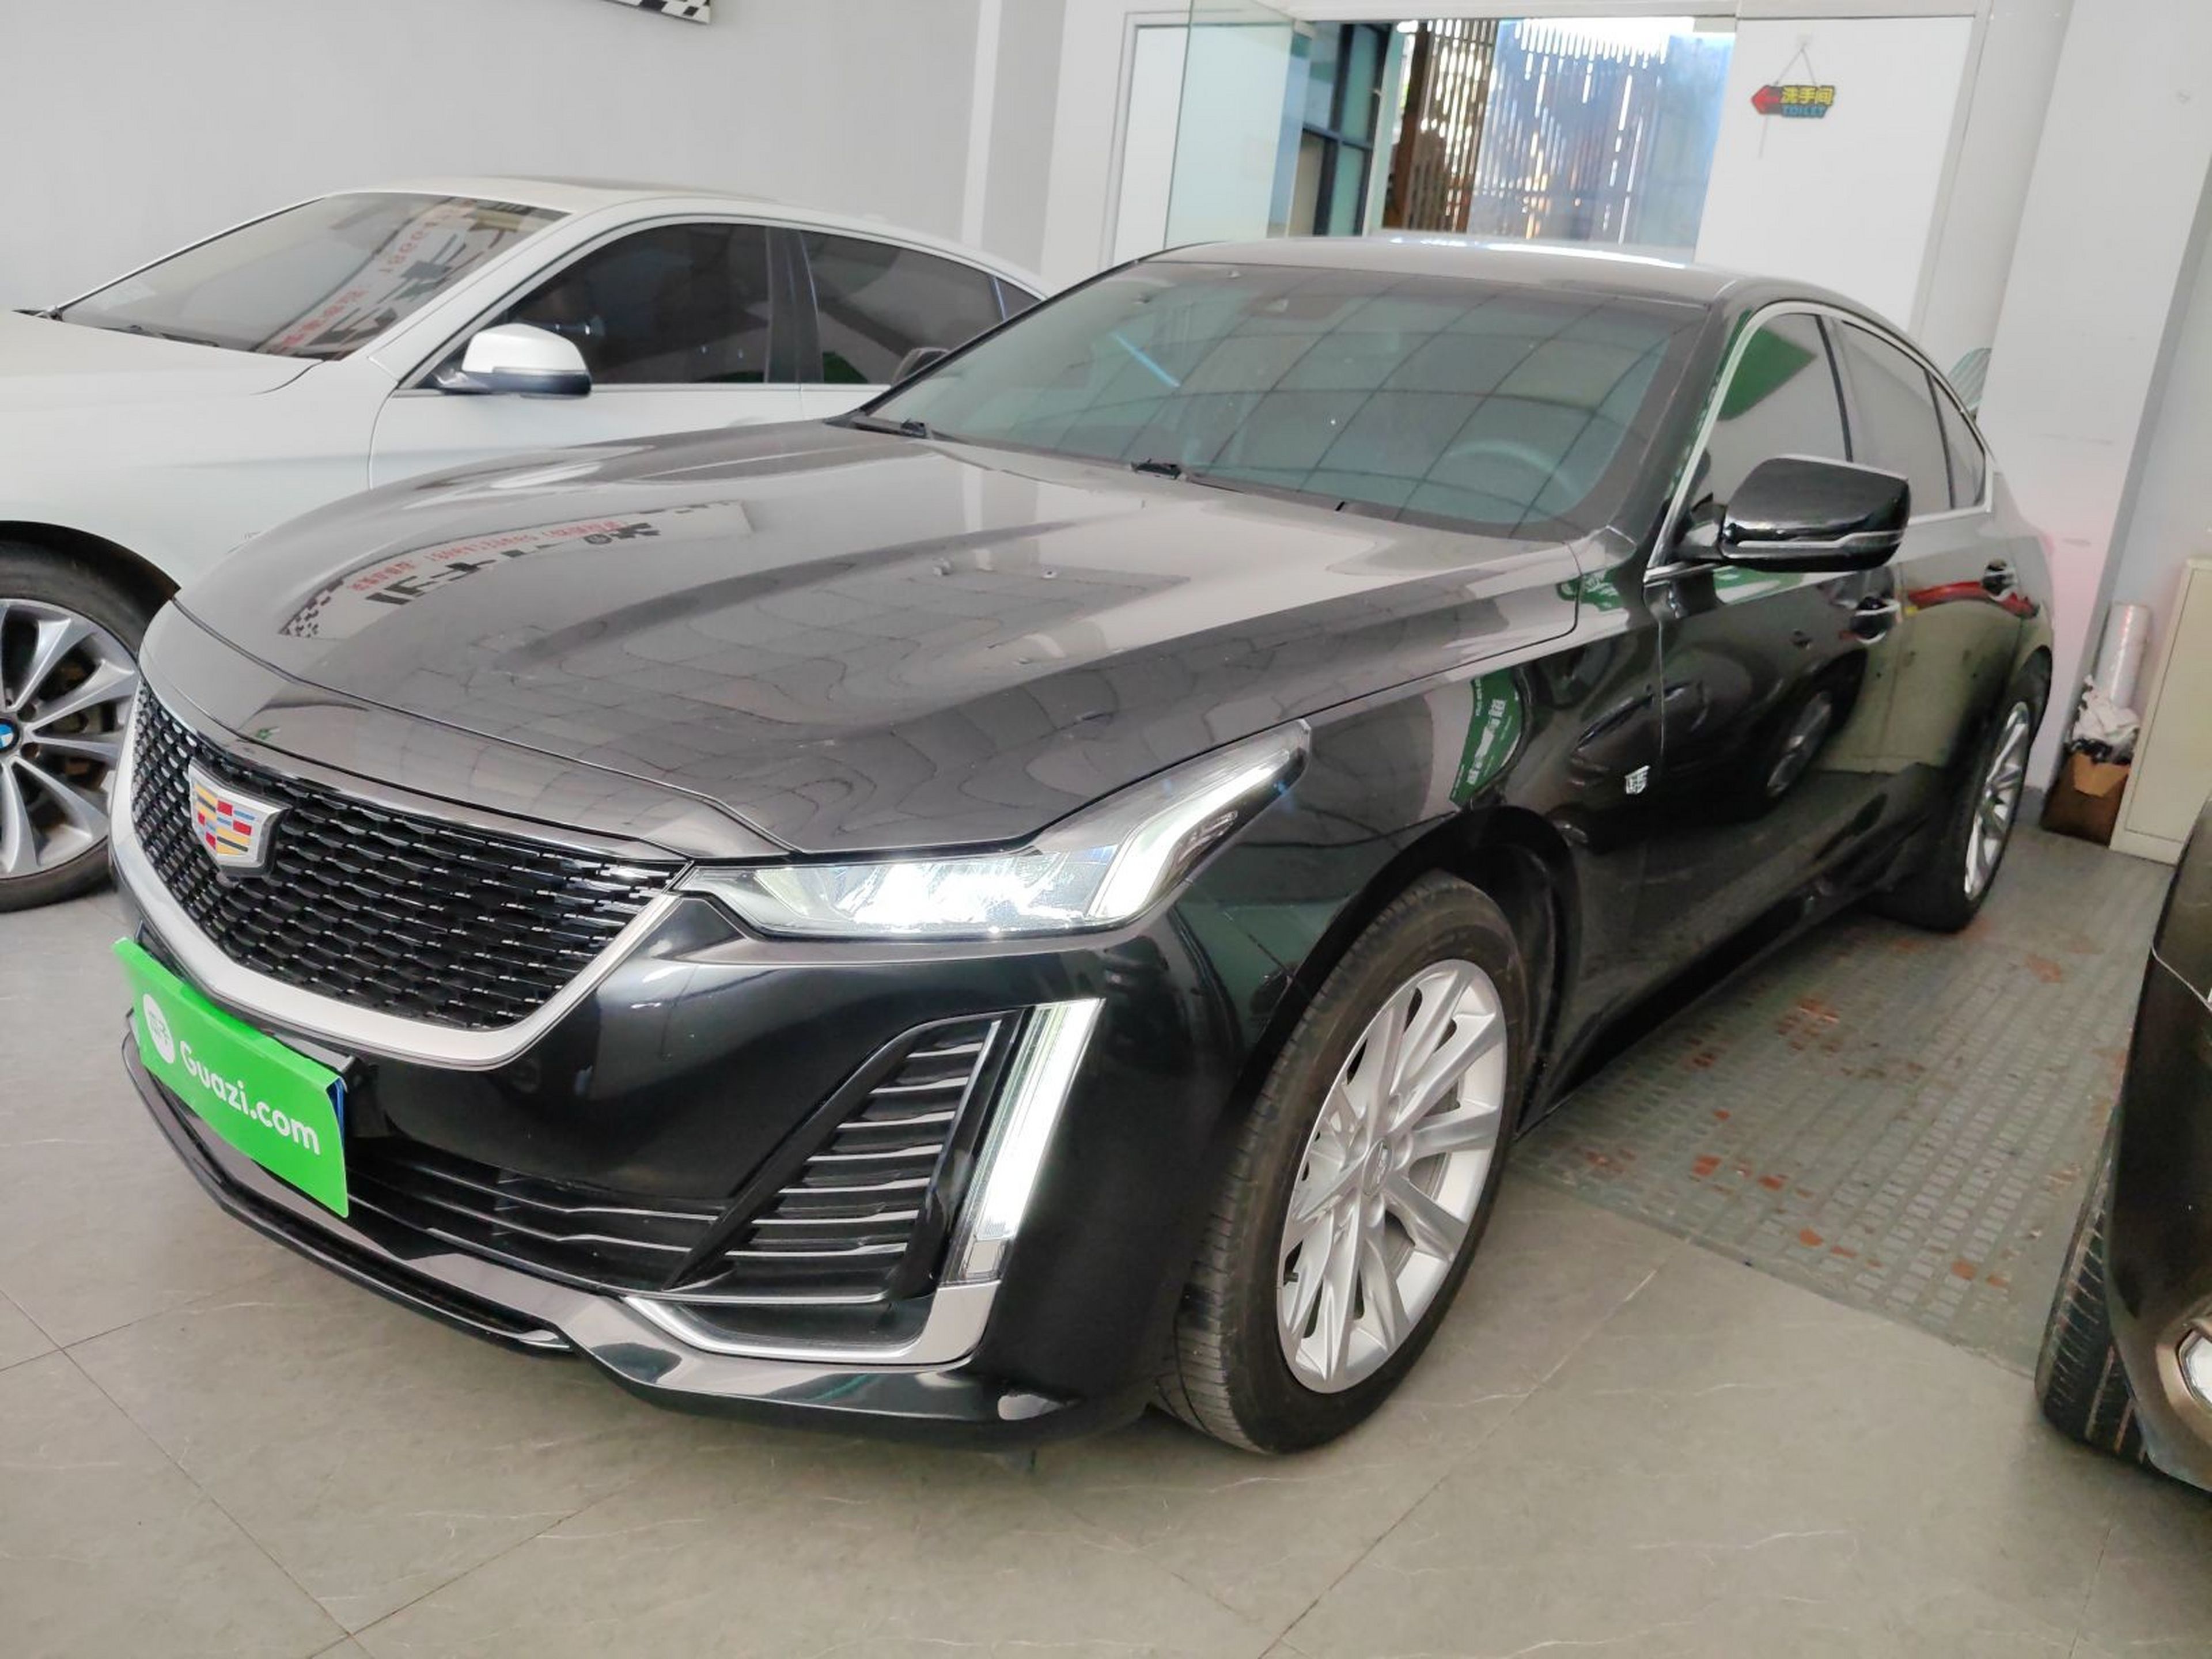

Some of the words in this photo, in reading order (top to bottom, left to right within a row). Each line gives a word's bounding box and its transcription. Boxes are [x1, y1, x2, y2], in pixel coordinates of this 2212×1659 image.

[1781, 86, 1833, 105] 洗手间
[1783, 105, 1825, 116] TOILET
[180, 1040, 321, 1156] Guazi.com
